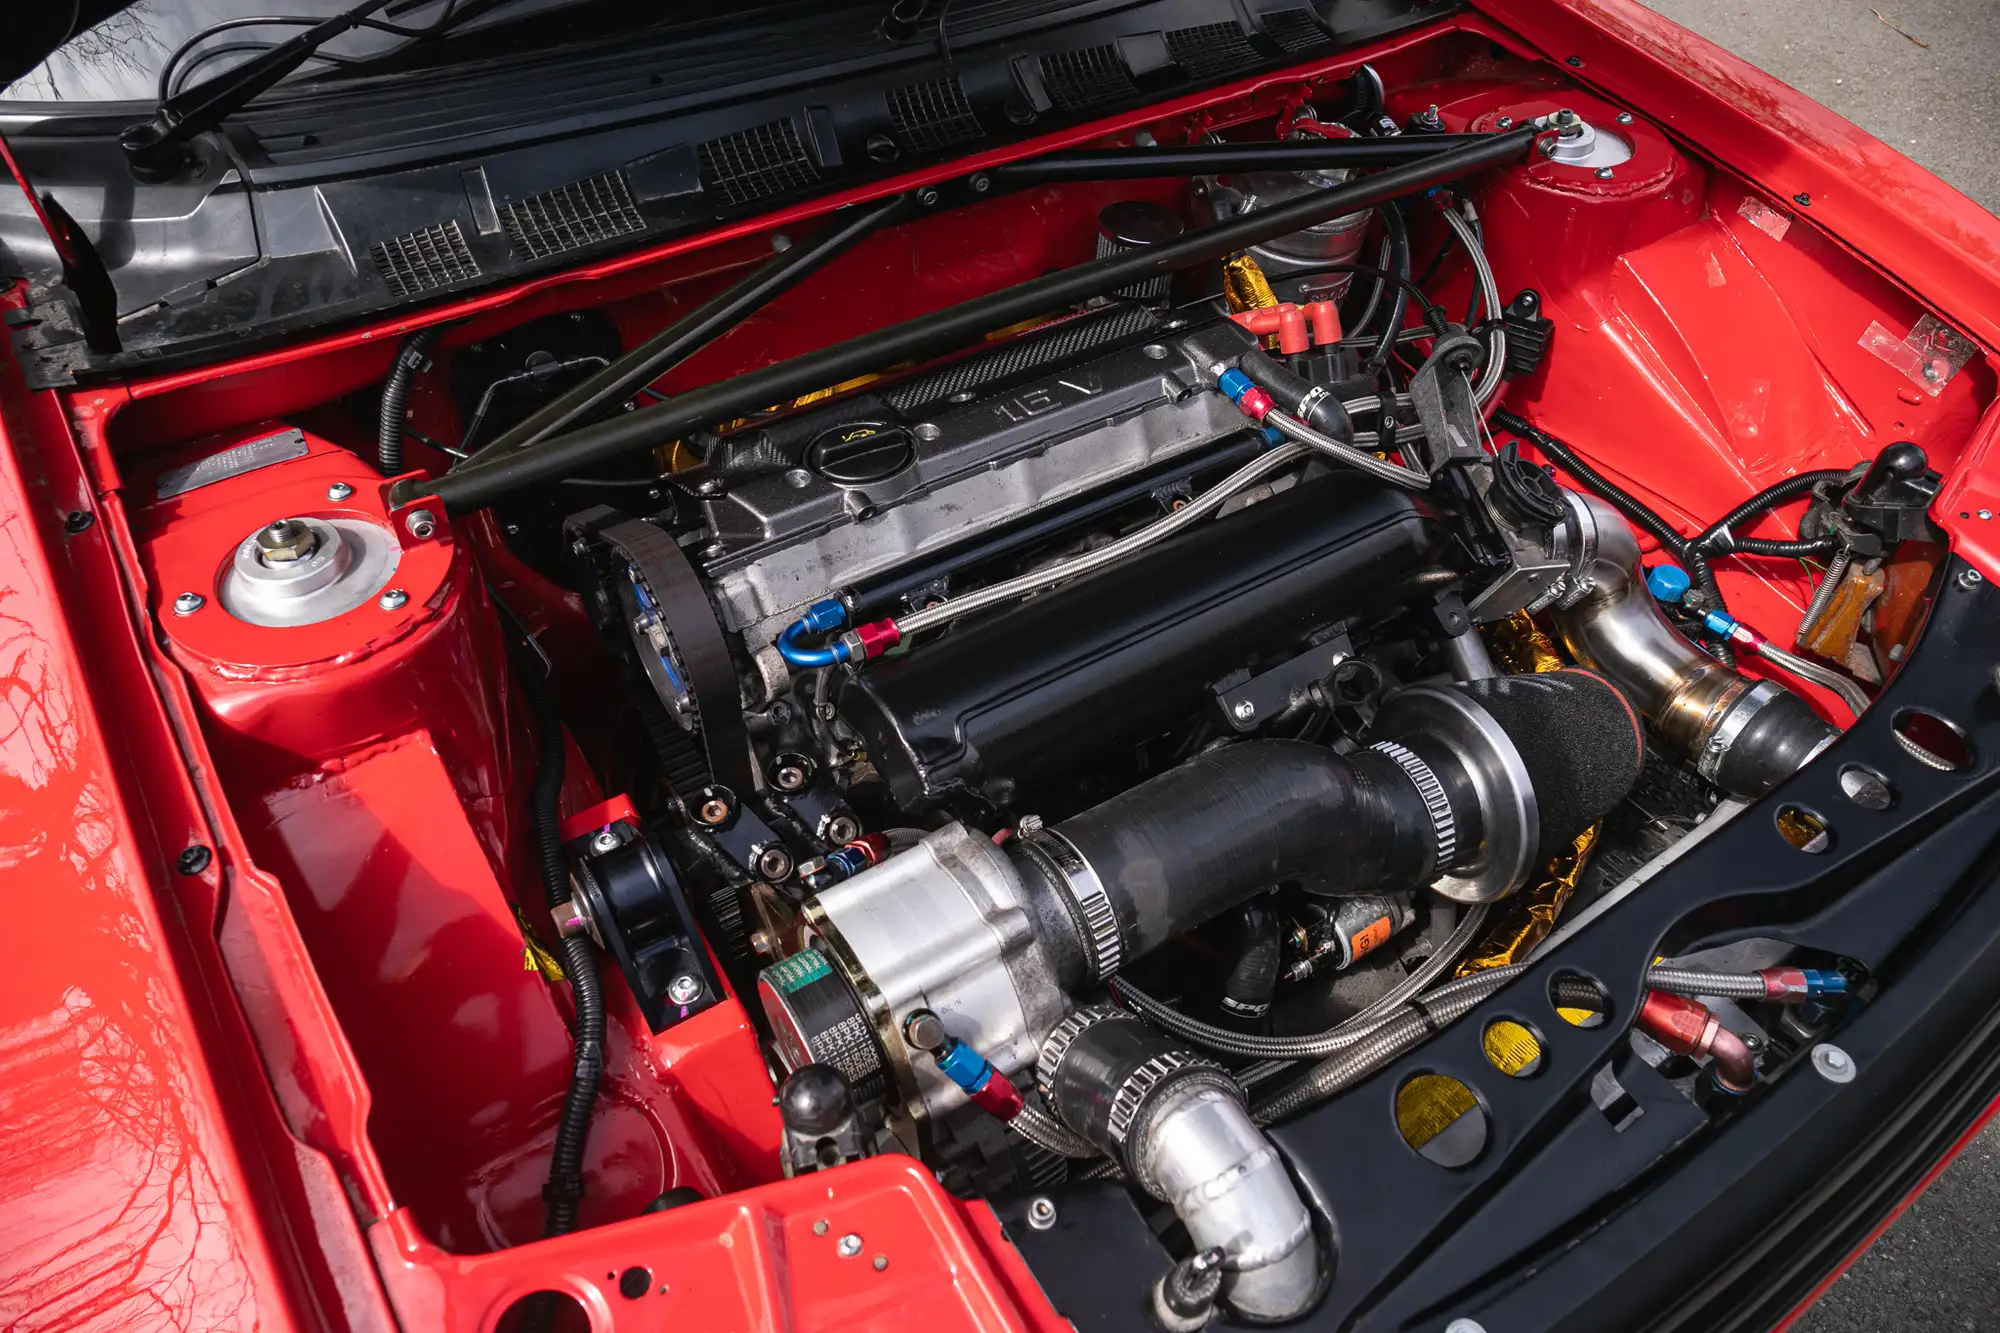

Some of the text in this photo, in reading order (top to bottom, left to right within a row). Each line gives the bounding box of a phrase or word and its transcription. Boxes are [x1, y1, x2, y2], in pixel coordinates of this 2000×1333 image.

[828, 1026, 858, 1083] 8PK1150ES
[837, 1021, 867, 1078] 8PK1150ES
[846, 1016, 876, 1073] 8PK1150ES
